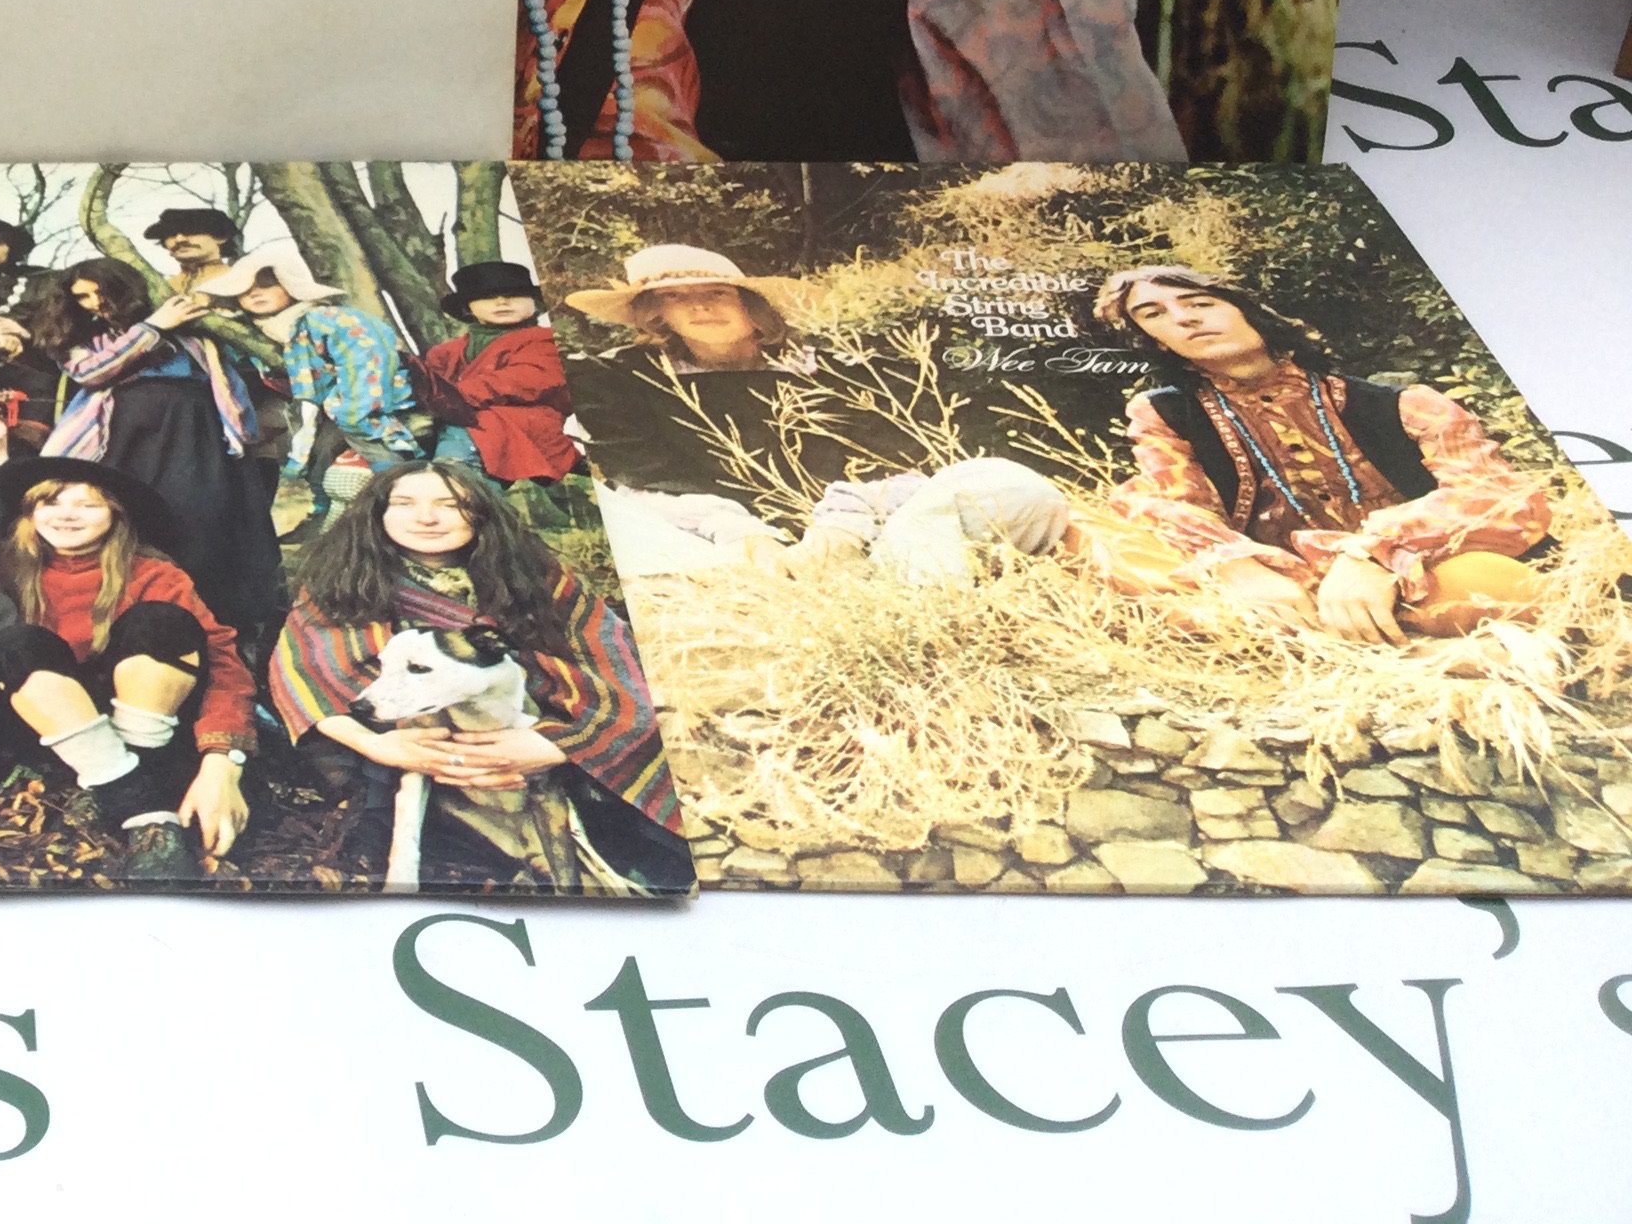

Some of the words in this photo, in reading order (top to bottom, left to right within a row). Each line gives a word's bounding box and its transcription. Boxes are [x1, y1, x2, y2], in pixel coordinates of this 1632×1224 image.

[940, 246, 1011, 271] The
[915, 270, 1091, 293] Incredible
[941, 293, 1050, 320] String
[971, 316, 1079, 339] Band
[942, 346, 1037, 374] Wee
[1044, 346, 1153, 375] Tam
